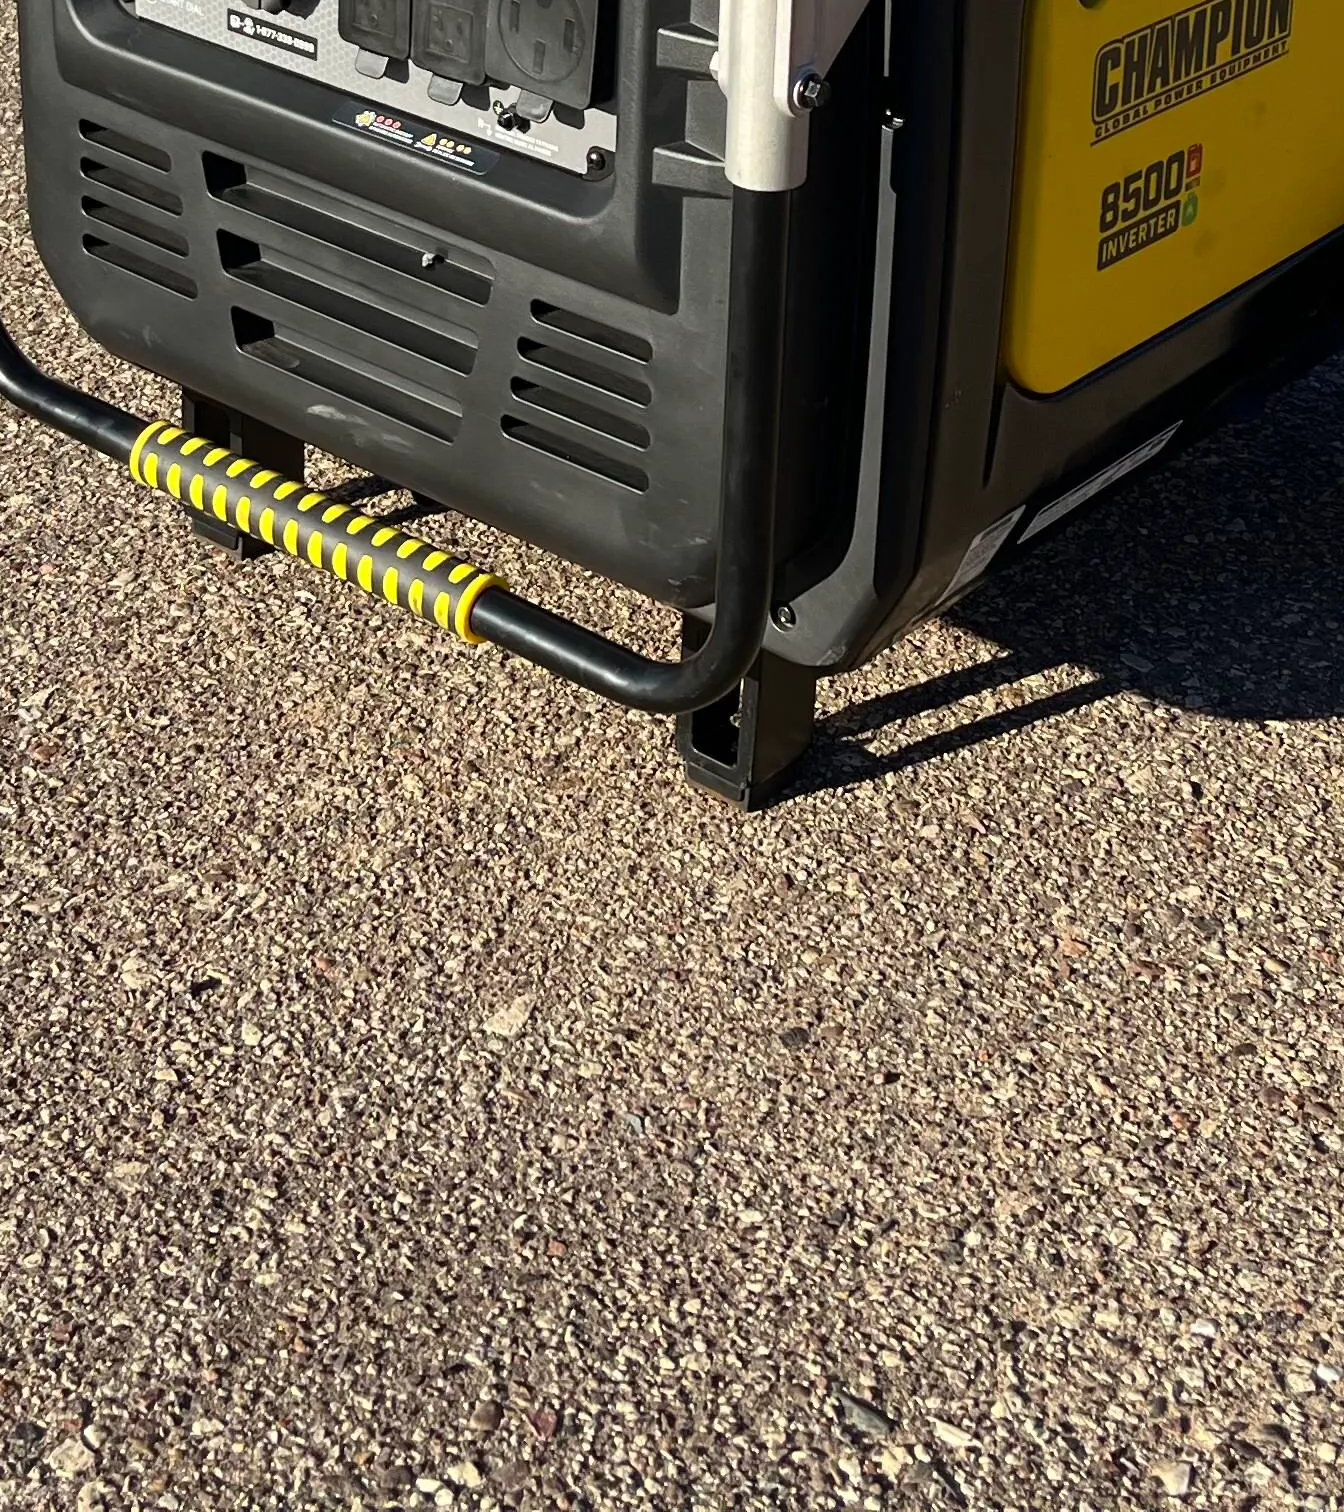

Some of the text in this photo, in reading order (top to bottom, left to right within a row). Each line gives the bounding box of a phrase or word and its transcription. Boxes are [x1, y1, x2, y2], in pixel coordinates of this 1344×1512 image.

[1095, 39, 1289, 139] GLOBAL POWER EQUIPMENT
[1100, 150, 1185, 233] 8500
[1102, 206, 1177, 263] INVERTER
